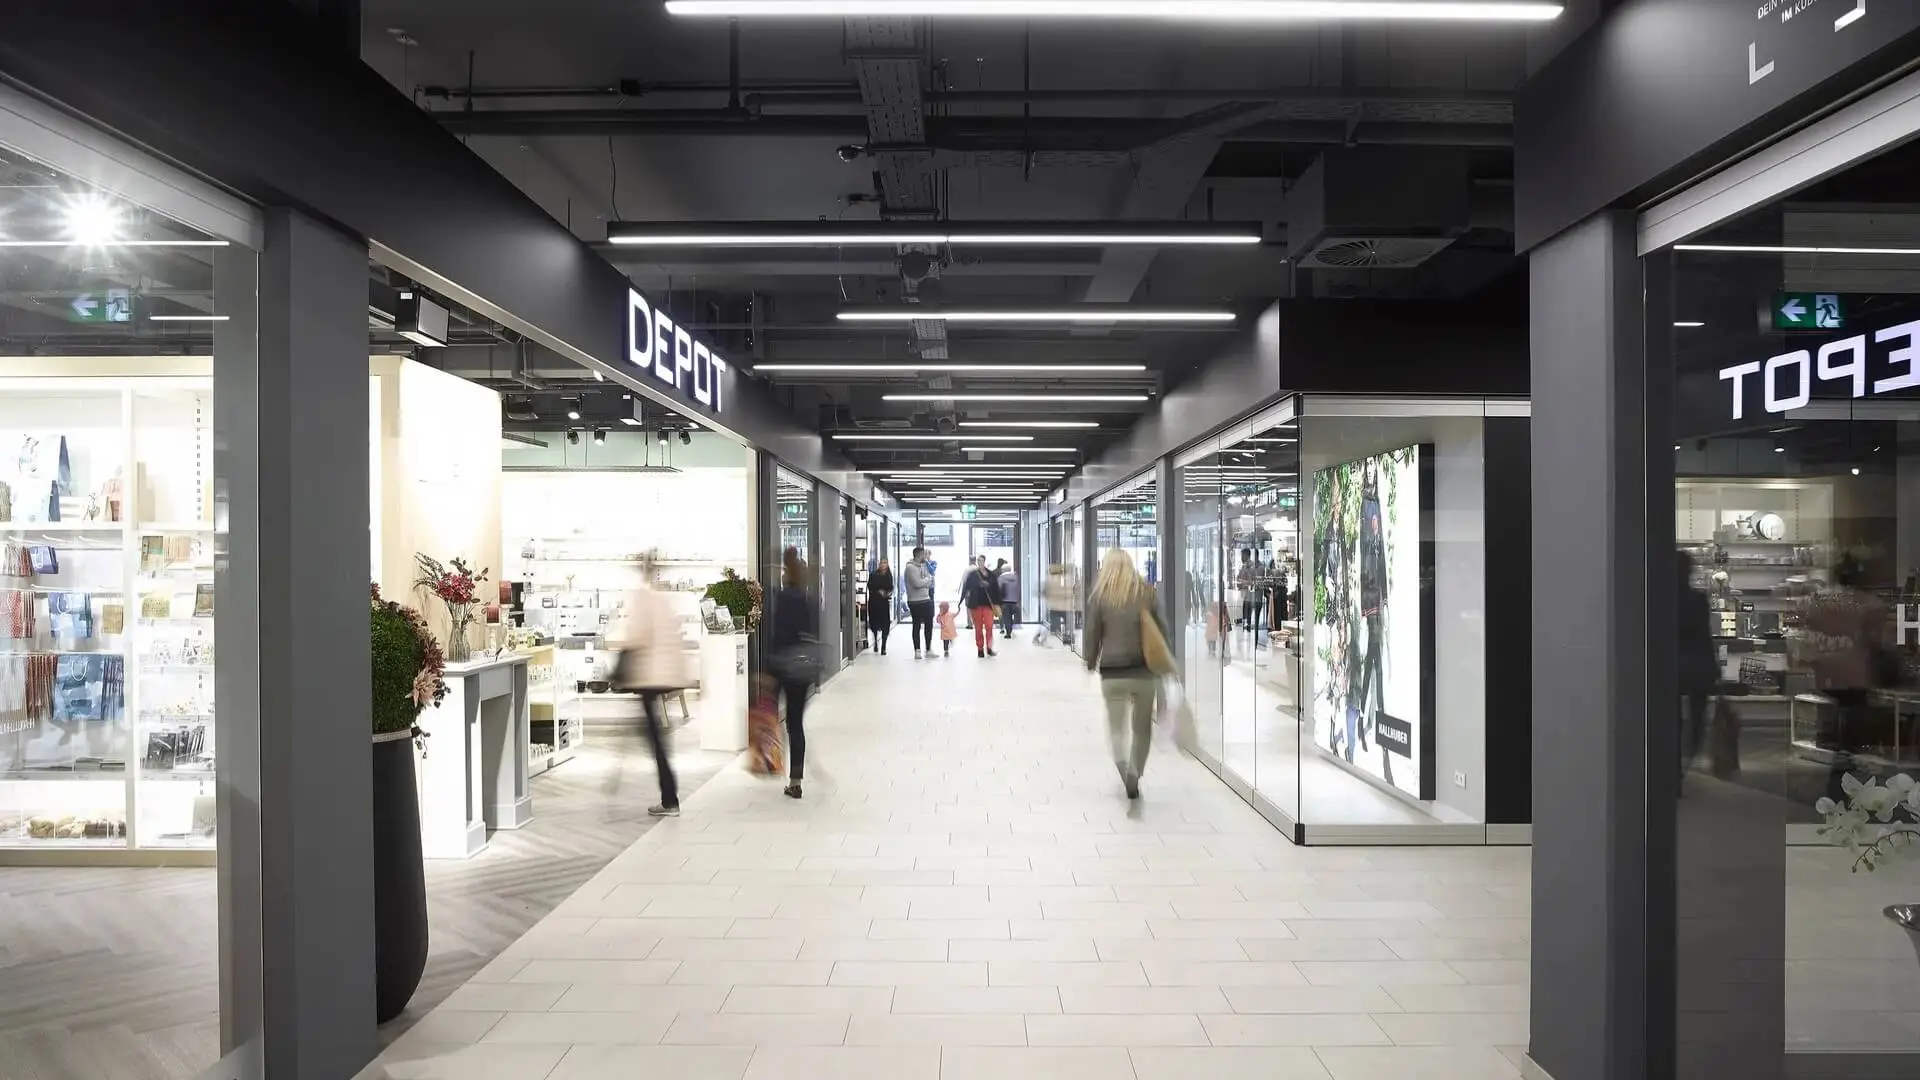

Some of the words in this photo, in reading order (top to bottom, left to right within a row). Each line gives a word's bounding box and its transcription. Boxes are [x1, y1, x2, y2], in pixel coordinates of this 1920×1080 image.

[1757, 0, 1778, 20] DEIN
[1781, 7, 1793, 24] IM
[629, 287, 726, 413] DEPOT
